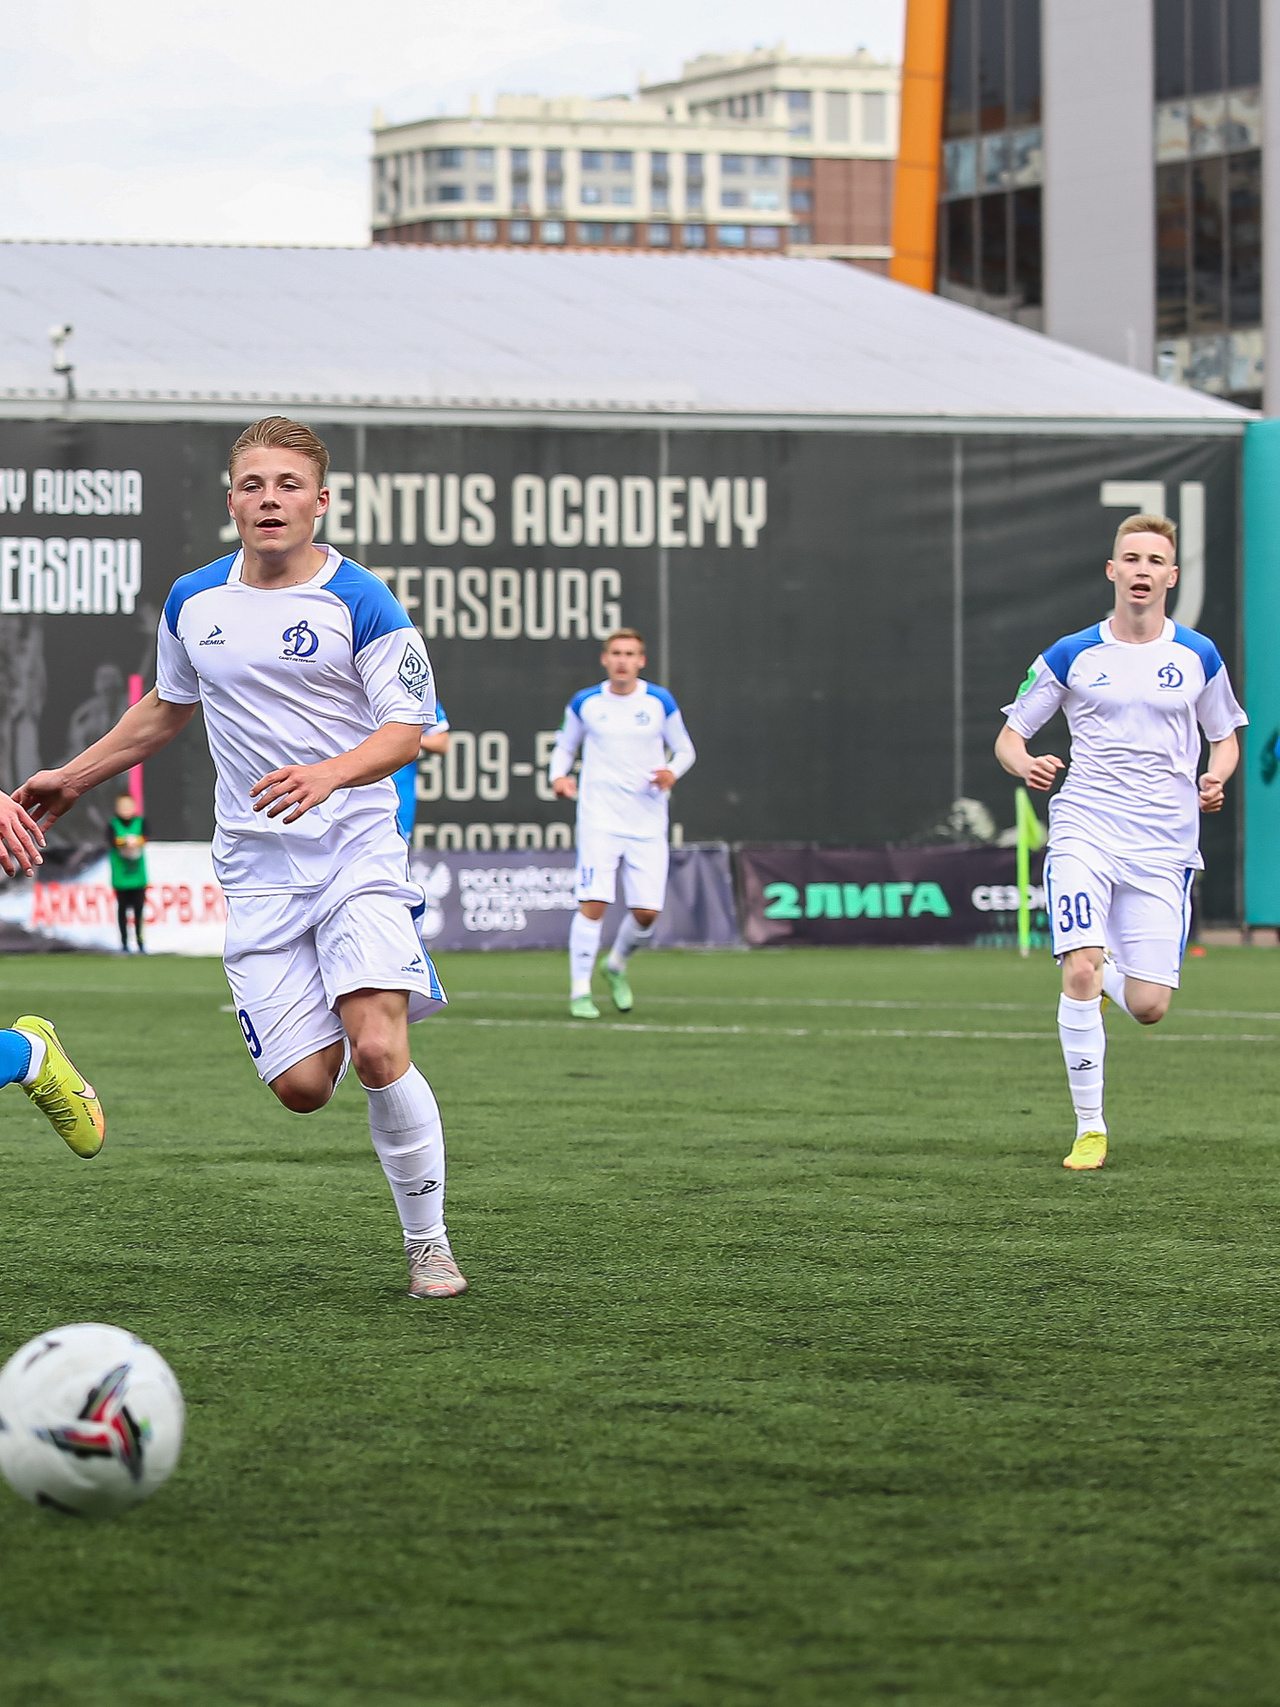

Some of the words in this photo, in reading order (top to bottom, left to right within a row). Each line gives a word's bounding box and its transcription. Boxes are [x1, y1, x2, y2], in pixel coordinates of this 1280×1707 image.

[33, 469, 143, 516] RUSSIA
[220, 472, 496, 547] ENTUS
[512, 474, 767, 550] ACADEMY
[31, 881, 228, 926] ARKHYSPB.R
[764, 882, 803, 919] 2
[804, 881, 952, 918] ЛИГА
[1058, 892, 1092, 933] 30
